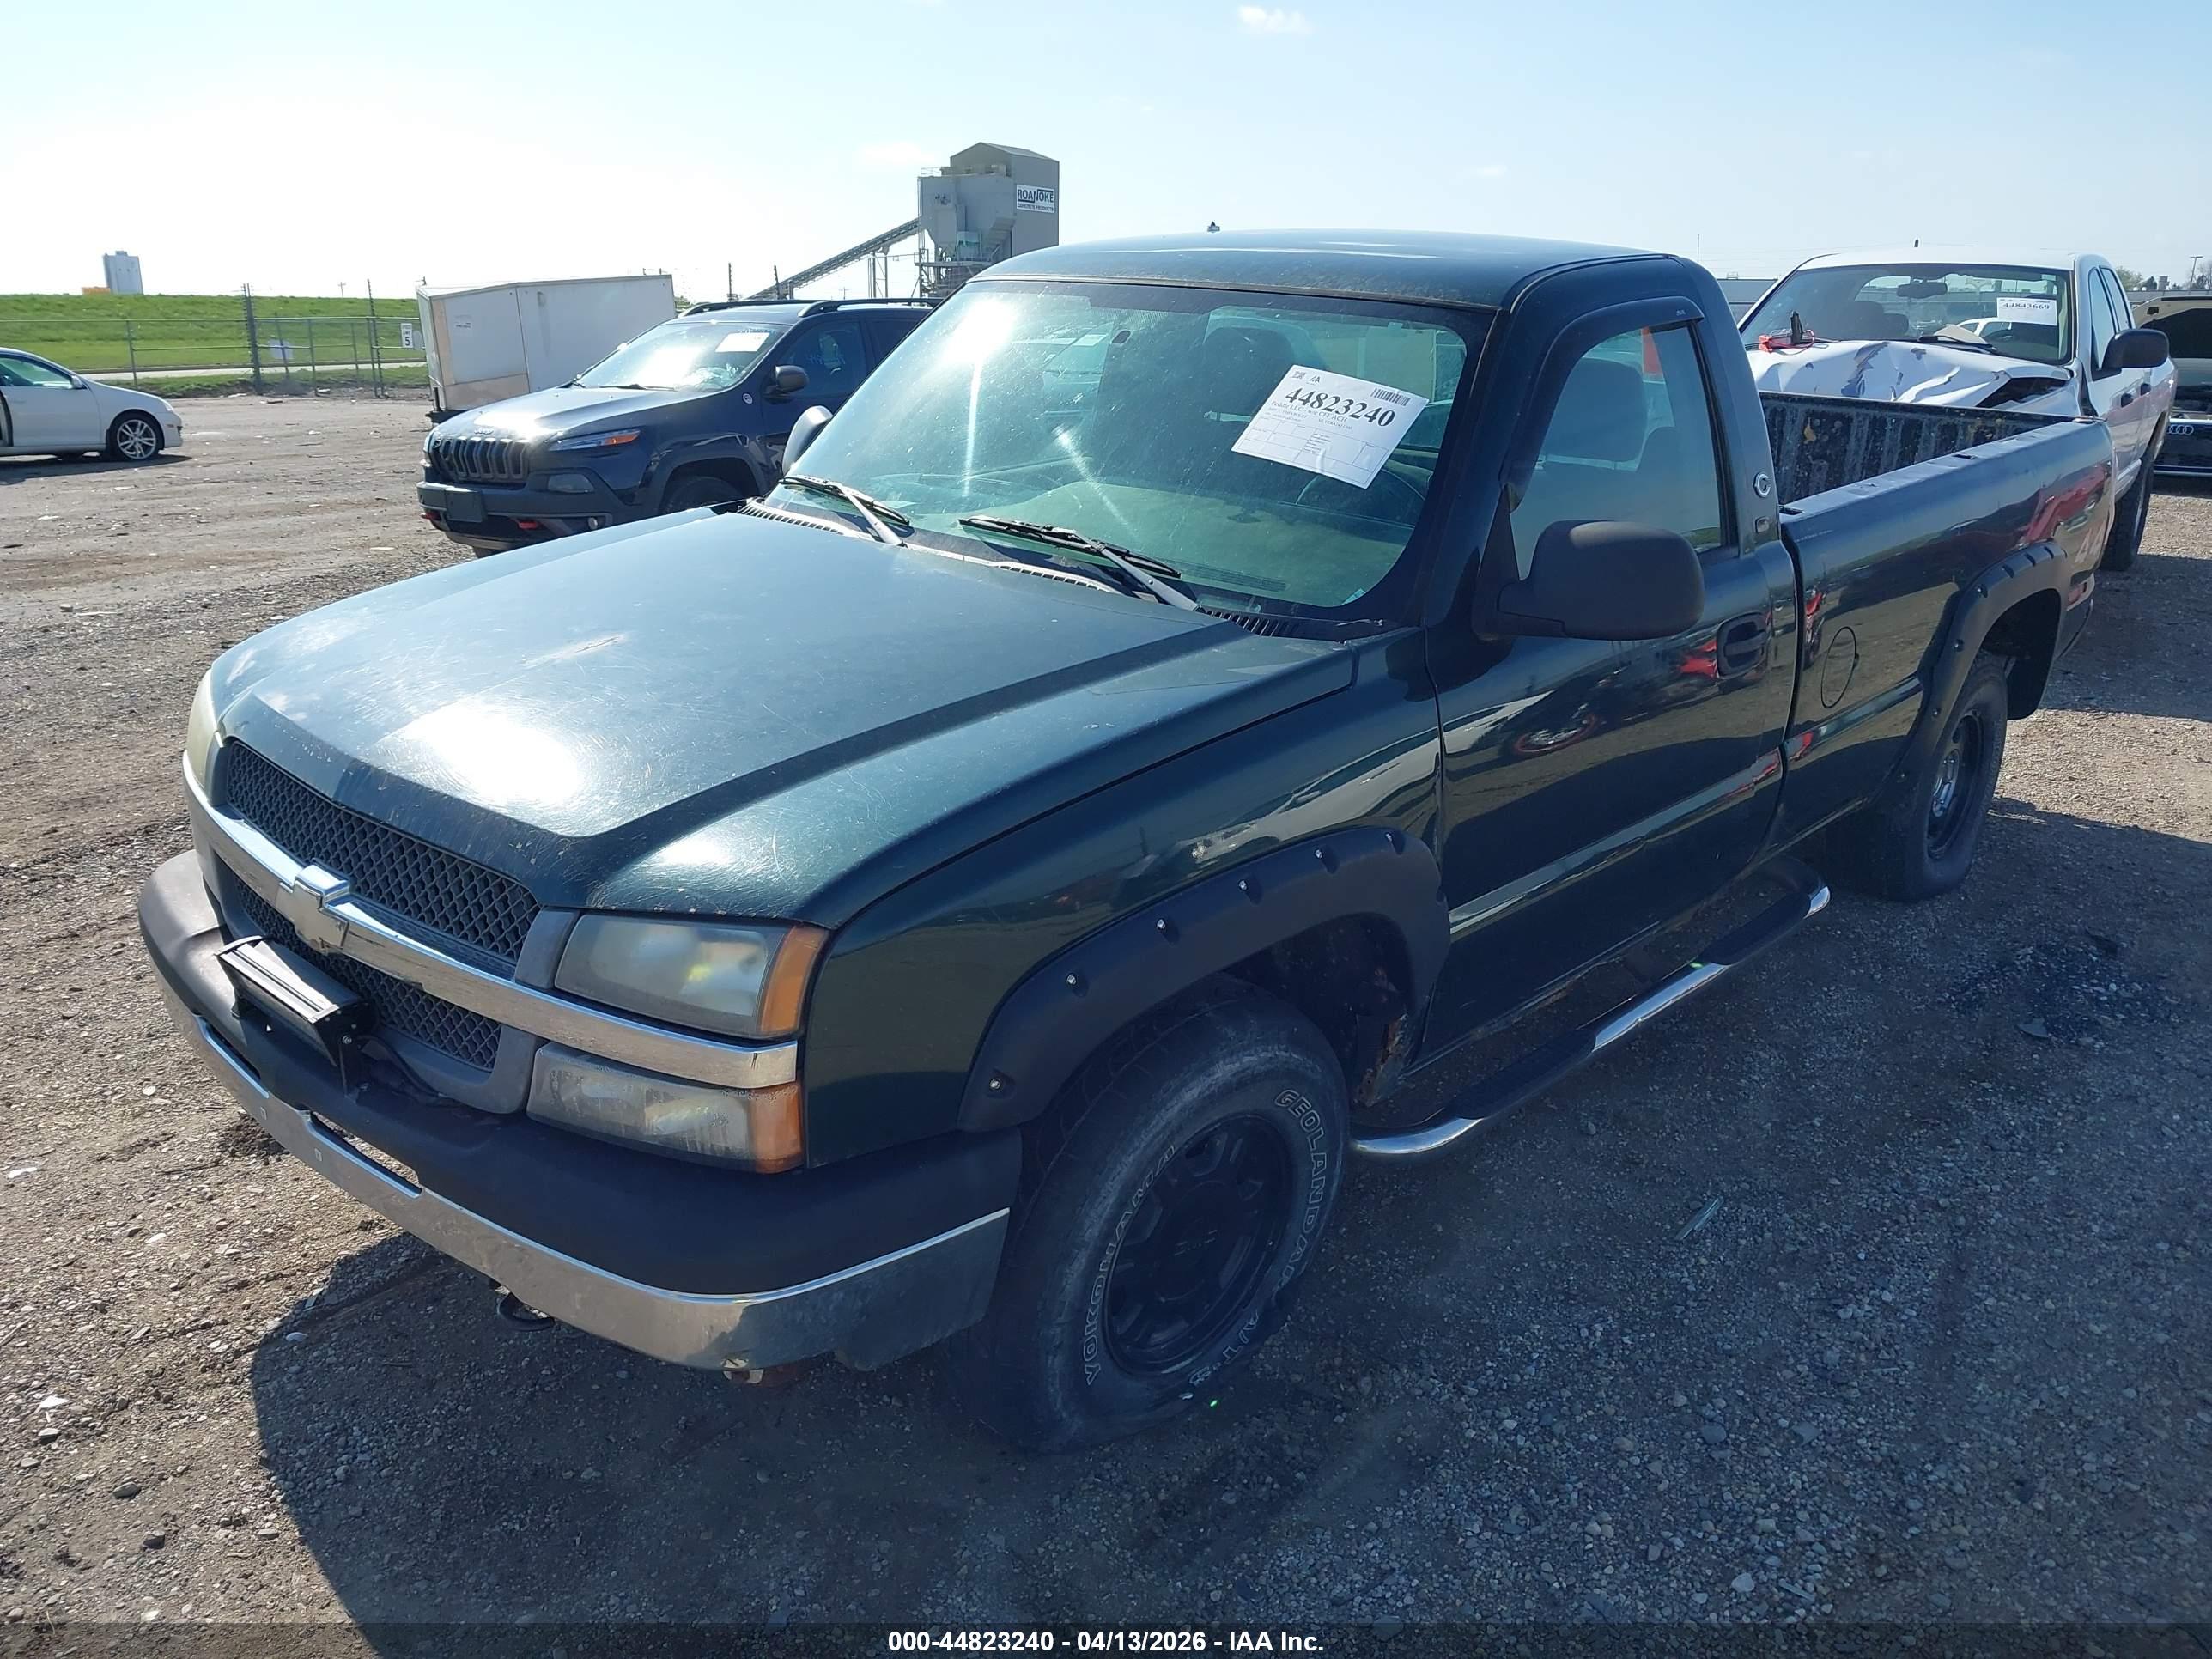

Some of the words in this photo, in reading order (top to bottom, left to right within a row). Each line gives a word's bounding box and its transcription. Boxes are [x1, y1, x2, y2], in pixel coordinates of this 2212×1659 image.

[1018, 189, 1054, 203] ROANOKE
[405, 337, 410, 346] 5
[1285, 387, 1395, 427] 44823240
[1083, 1145, 1176, 1385] YOKOHAMA
